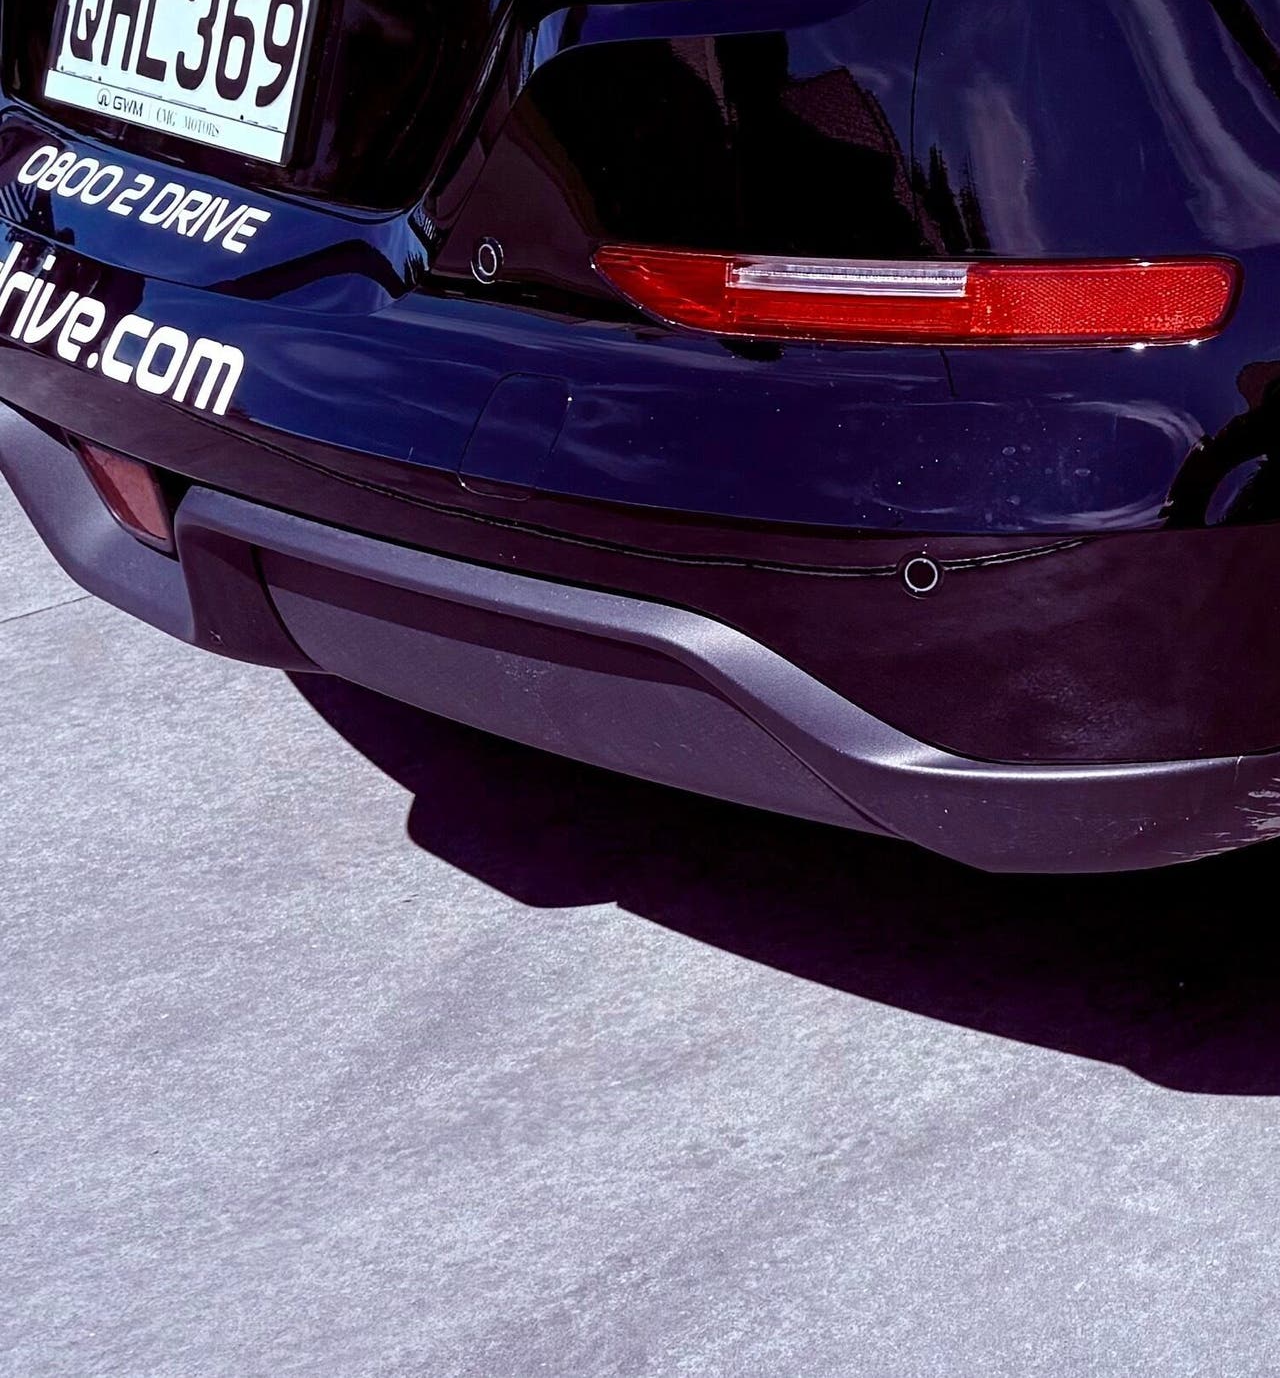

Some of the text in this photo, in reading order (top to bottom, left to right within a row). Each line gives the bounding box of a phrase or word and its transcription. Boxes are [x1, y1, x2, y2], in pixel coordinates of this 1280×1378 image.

[113, 95, 143, 117] GWM
[17, 145, 271, 254] 0800 2 DRIVE
